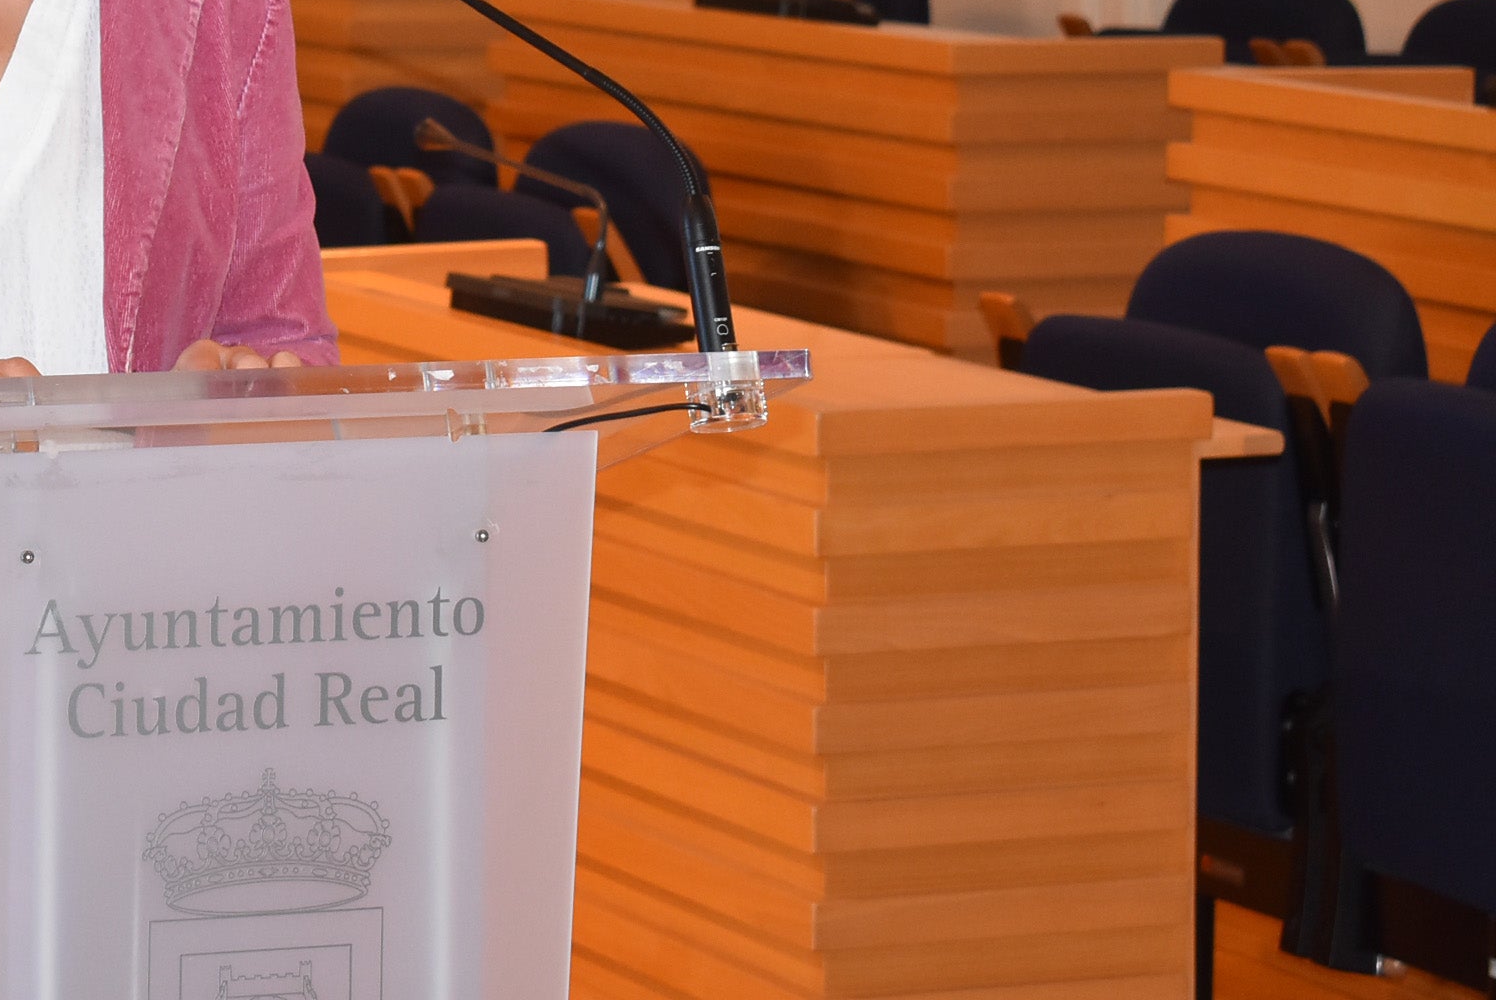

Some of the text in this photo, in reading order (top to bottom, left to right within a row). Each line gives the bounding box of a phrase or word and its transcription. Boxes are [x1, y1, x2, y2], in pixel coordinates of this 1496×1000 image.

[24, 586, 485, 668] Ayuntamiento
[67, 665, 447, 738] Ciudad Real
